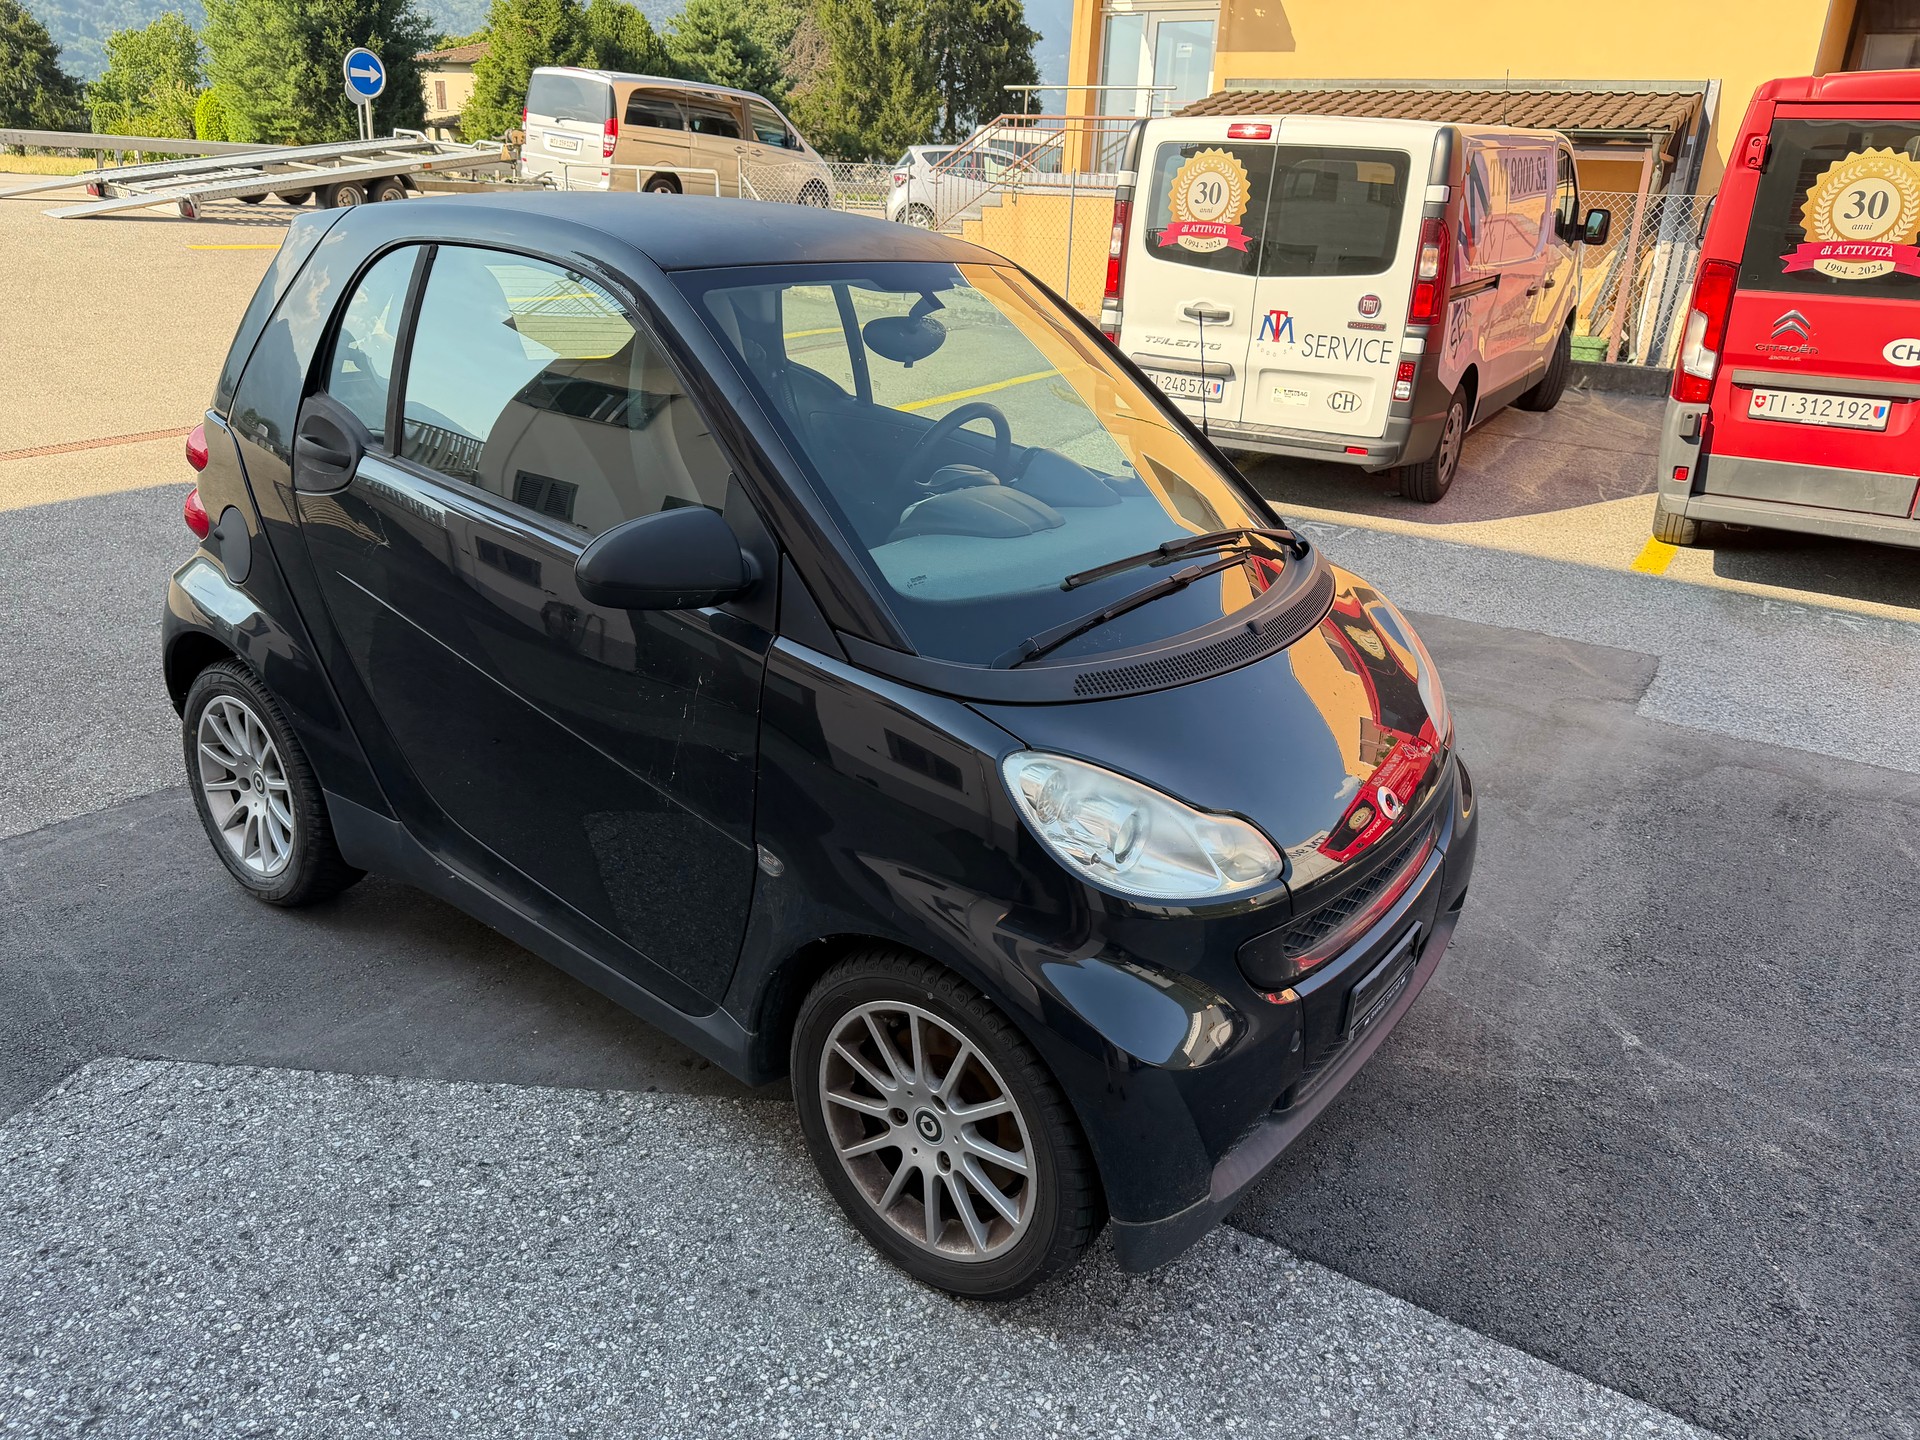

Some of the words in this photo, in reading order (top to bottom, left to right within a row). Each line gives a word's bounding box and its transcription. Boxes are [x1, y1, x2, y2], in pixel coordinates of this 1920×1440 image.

[1511, 157, 1534, 194] 9000
[1194, 181, 1222, 205] 30
[1843, 190, 1890, 219] 30
[1181, 224, 1189, 233] di
[1190, 224, 1227, 235] ATTIVITÀ
[1851, 222, 1874, 231] anni
[1184, 237, 1199, 249] 1994
[1205, 239, 1221, 249] 2024
[1820, 245, 1832, 255] di
[1833, 244, 1894, 257] ATTIVITÀ
[1824, 261, 1849, 275] 1994
[1858, 263, 1884, 275] 2024
[1362, 299, 1378, 312] FIAT
[1145, 335, 1222, 351] TALENTO
[1301, 333, 1394, 364] SERVICE
[1755, 343, 1819, 355] CITROËN
[1892, 344, 1920, 361] CH
[1331, 392, 1355, 411] CH
